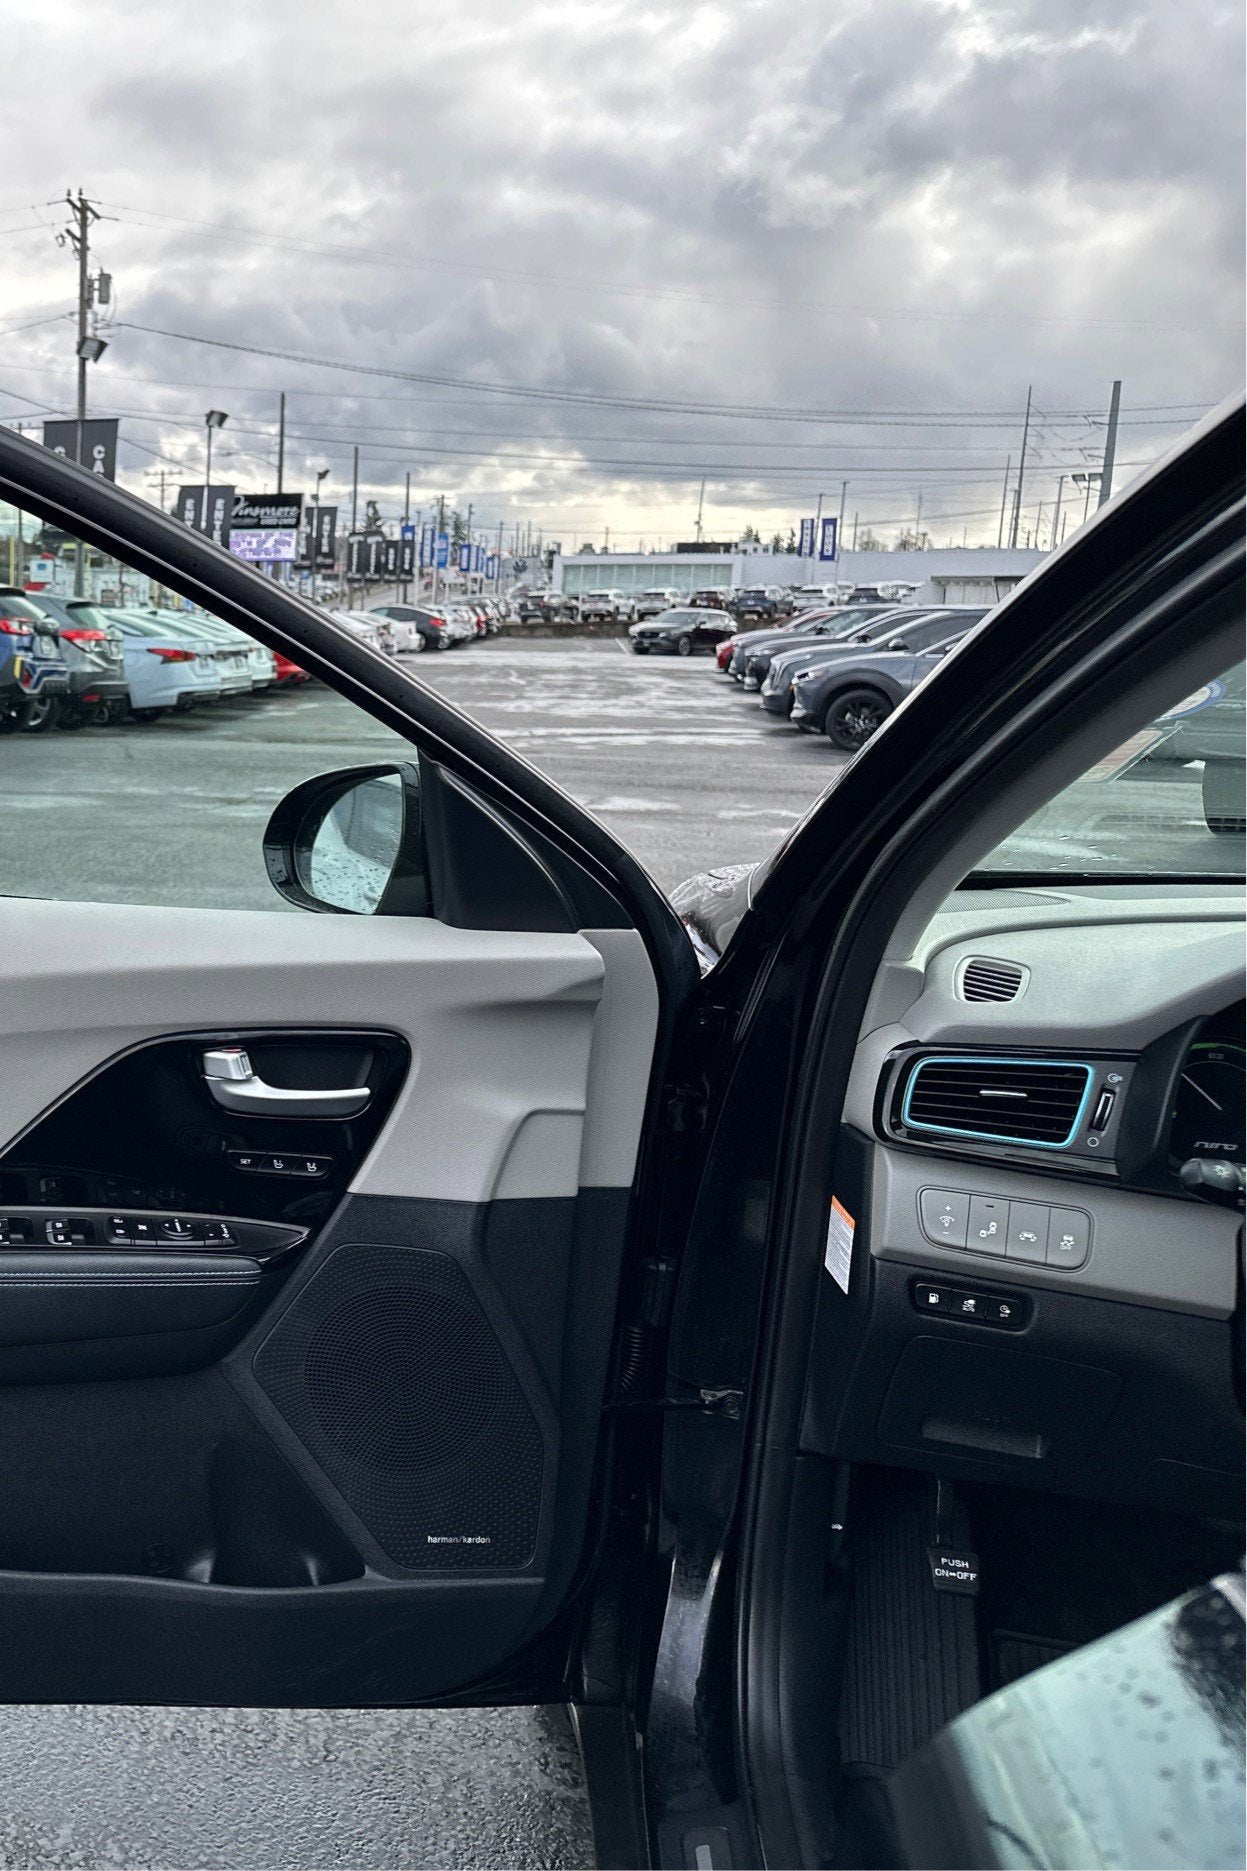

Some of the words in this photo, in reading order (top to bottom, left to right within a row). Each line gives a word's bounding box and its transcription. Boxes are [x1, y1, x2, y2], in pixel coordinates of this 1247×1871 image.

[184, 498, 196, 528] ENT
[212, 498, 226, 547] ENTE
[427, 1535, 491, 1544] harman/kardon
[941, 1557, 969, 1569] PUSH
